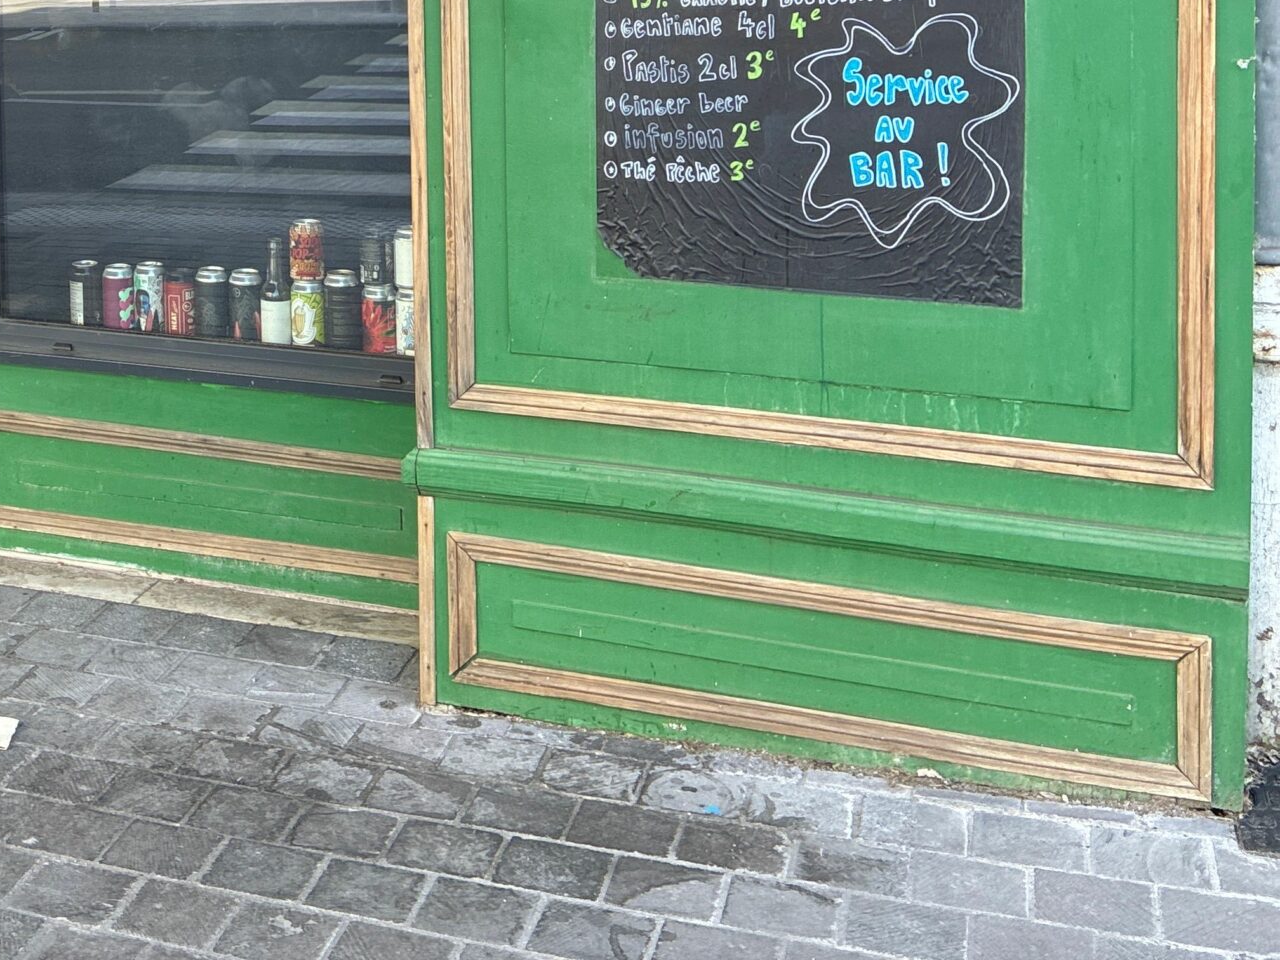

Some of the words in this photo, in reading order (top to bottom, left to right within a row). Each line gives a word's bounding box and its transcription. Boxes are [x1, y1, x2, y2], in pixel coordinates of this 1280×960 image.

[737, 10, 776, 40] 4cl
[697, 52, 738, 82] 2cl
[842, 56, 970, 107] Service
[698, 92, 749, 114] beer
[624, 122, 724, 153] infusion
[620, 155, 657, 183] Thé
[849, 150, 926, 189] BAR
